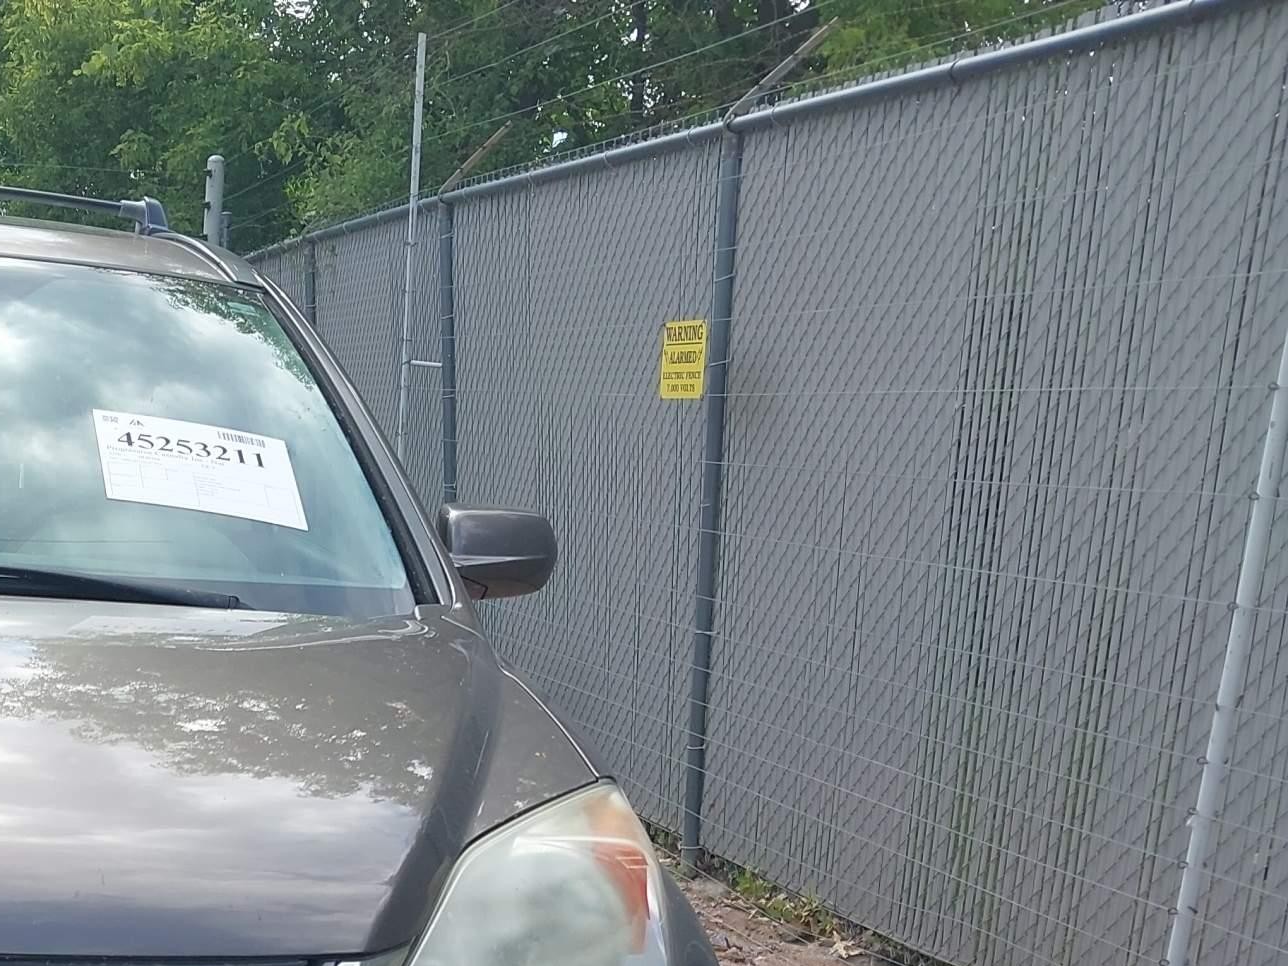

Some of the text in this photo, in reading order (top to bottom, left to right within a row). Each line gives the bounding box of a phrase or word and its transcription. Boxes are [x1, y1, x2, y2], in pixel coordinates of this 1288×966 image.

[666, 324, 703, 342] WARNING
[669, 351, 697, 364] ALARMED
[663, 371, 701, 380] ELECTRIC FENCE
[680, 384, 695, 392] VOLTS
[117, 431, 265, 469] 45253211
